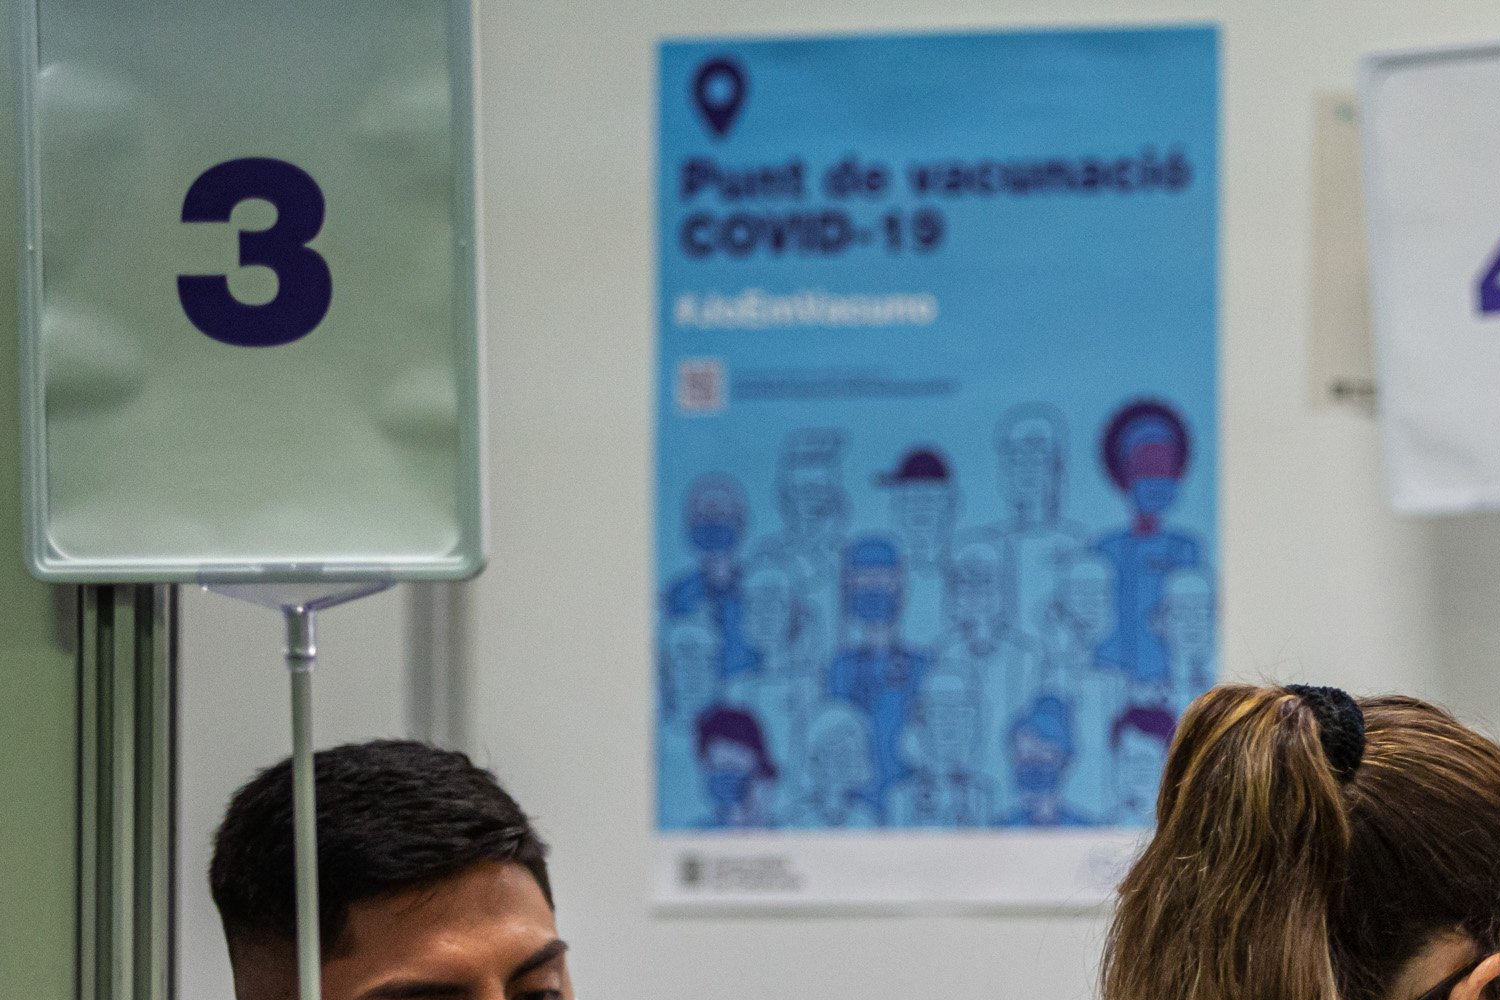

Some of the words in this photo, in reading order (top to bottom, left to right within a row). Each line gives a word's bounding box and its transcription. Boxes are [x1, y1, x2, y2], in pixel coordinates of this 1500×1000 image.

[681, 158, 804, 199] Punt
[824, 156, 888, 196] de
[908, 147, 1192, 195] vacunació
[177, 156, 333, 347] 3
[681, 209, 945, 258] COVID-19
